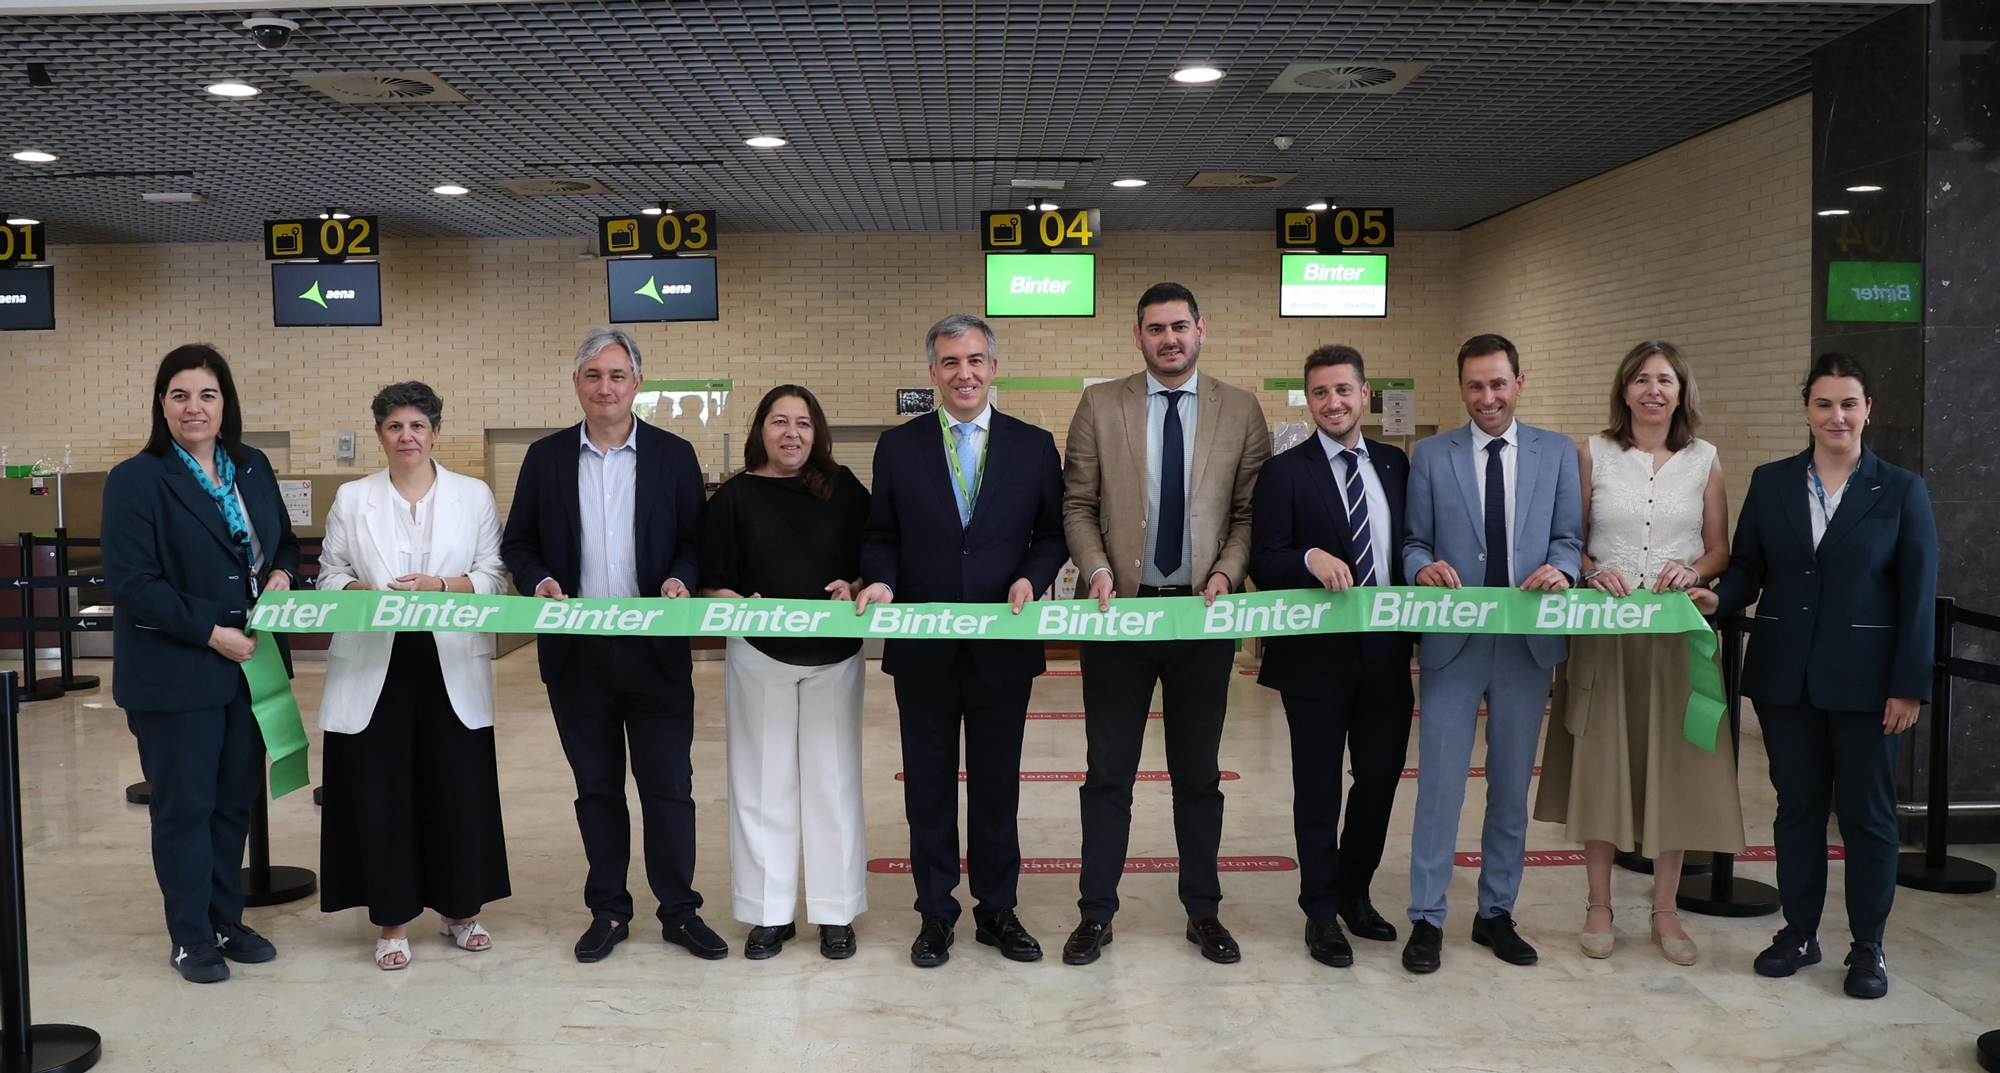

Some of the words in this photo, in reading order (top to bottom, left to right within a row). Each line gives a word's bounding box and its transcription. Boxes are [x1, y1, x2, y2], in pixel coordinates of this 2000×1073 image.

[320, 218, 371, 255] 02
[656, 213, 708, 251] 03
[1039, 210, 1093, 247] 04
[1334, 210, 1386, 246] 05
[1009, 276, 1072, 294] Binter
[1303, 263, 1366, 281] Binter
[325, 289, 355, 299] aena
[661, 284, 692, 294] aena
[250, 598, 338, 628] nter
[372, 595, 500, 628] Binter
[534, 601, 664, 631] Binter
[700, 602, 832, 633] Binter
[868, 605, 999, 635] Binter
[1036, 604, 1166, 636] Binter
[1204, 599, 1332, 634] Binter
[1370, 592, 1498, 628] Binter
[1535, 594, 1662, 629] Binter
[1021, 861, 1082, 870] tancia
